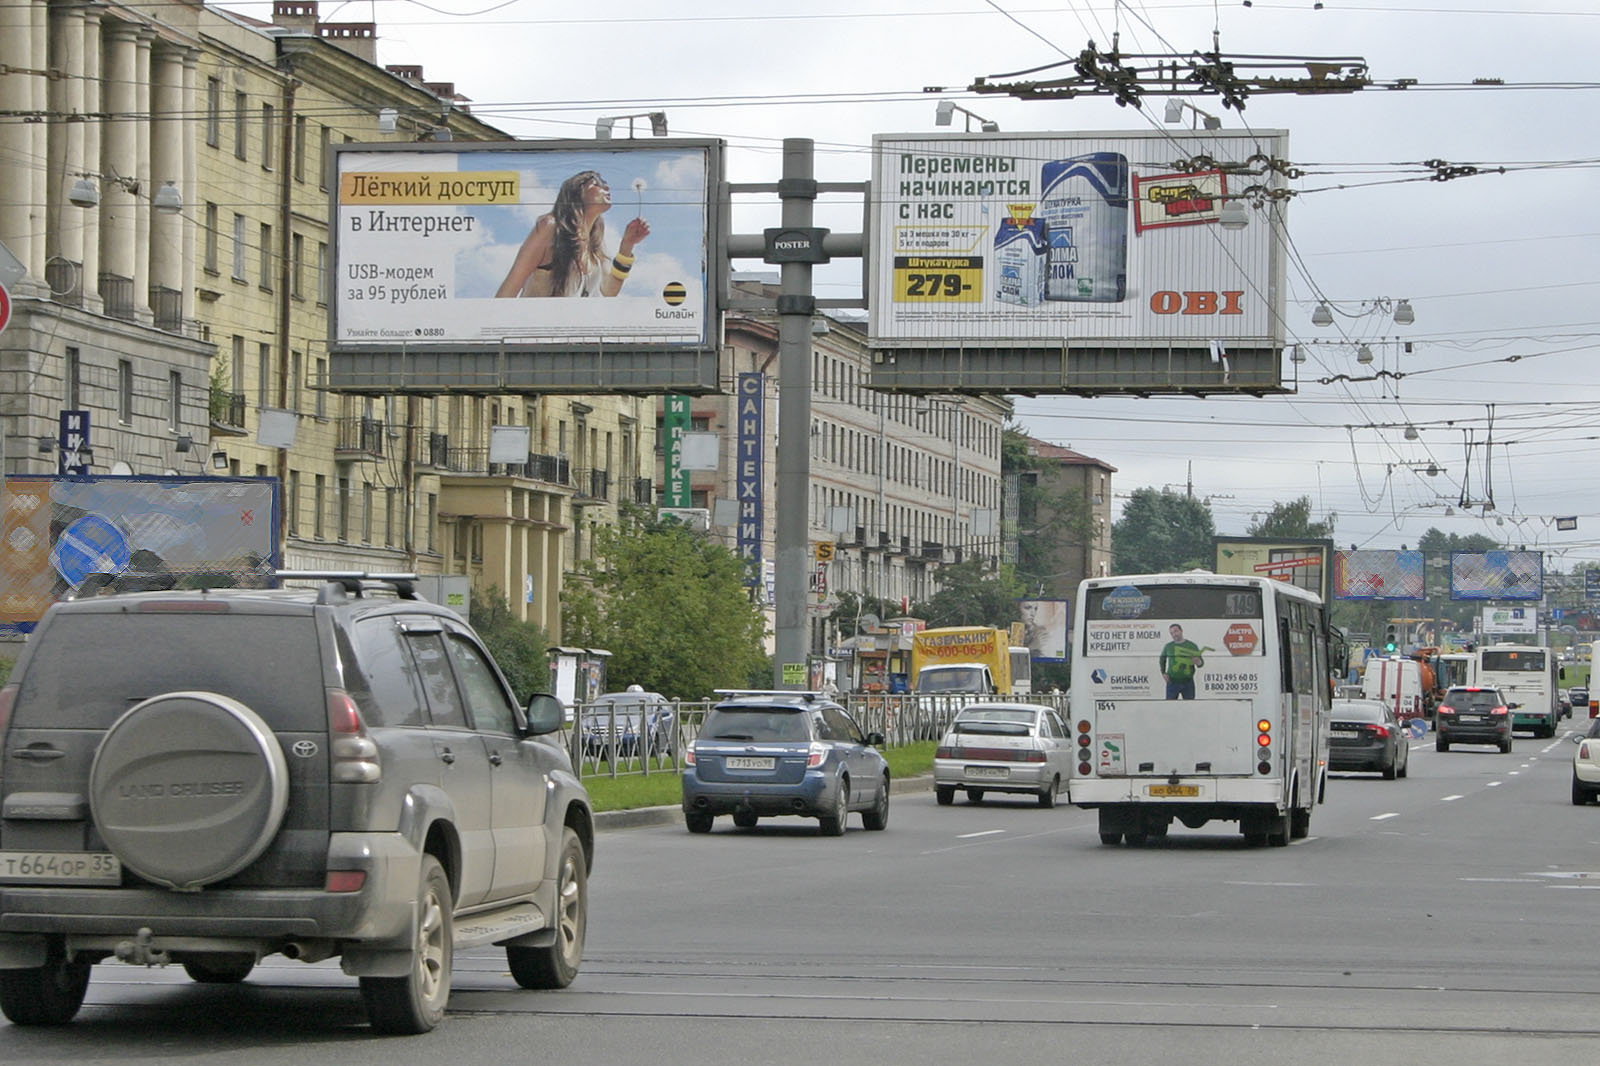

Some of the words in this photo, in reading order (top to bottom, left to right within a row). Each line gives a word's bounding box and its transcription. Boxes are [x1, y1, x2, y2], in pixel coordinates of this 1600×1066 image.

[901, 154, 1015, 178] Перемены
[351, 176, 431, 197] Лёгкий
[438, 180, 515, 201] доступ
[900, 180, 1030, 196] начинаются
[900, 204, 910, 219] с
[918, 204, 953, 219] нас
[351, 216, 362, 231] в
[369, 211, 474, 237] Интернет
[775, 240, 810, 249] POSTER
[908, 258, 969, 268] Штукатурка
[348, 264, 434, 281] USB-модем
[907, 274, 971, 296] 279-
[348, 289, 363, 300] за
[368, 286, 386, 300] 95
[391, 284, 447, 304] рублей
[1150, 291, 1244, 315] OBI
[424, 328, 445, 336] 0880
[671, 427, 683, 506] ПАРКЕТ
[1090, 631, 1110, 640] ЧЕГО
[1112, 631, 1127, 640] НЕТ
[1128, 631, 1135, 640] В
[1136, 631, 1160, 640] МОЕМ
[1090, 642, 1130, 651] КРЕДИТЕ?
[1110, 675, 1149, 684] БИНБАНК
[1204, 673, 1223, 682] (812)
[1224, 673, 1237, 681] 495
[1239, 673, 1248, 681] 60
[1249, 673, 1258, 681] 05
[170, 781, 245, 798] CRUISER
[6, 855, 85, 876] Т664ОР
[93, 855, 113, 871] 35
